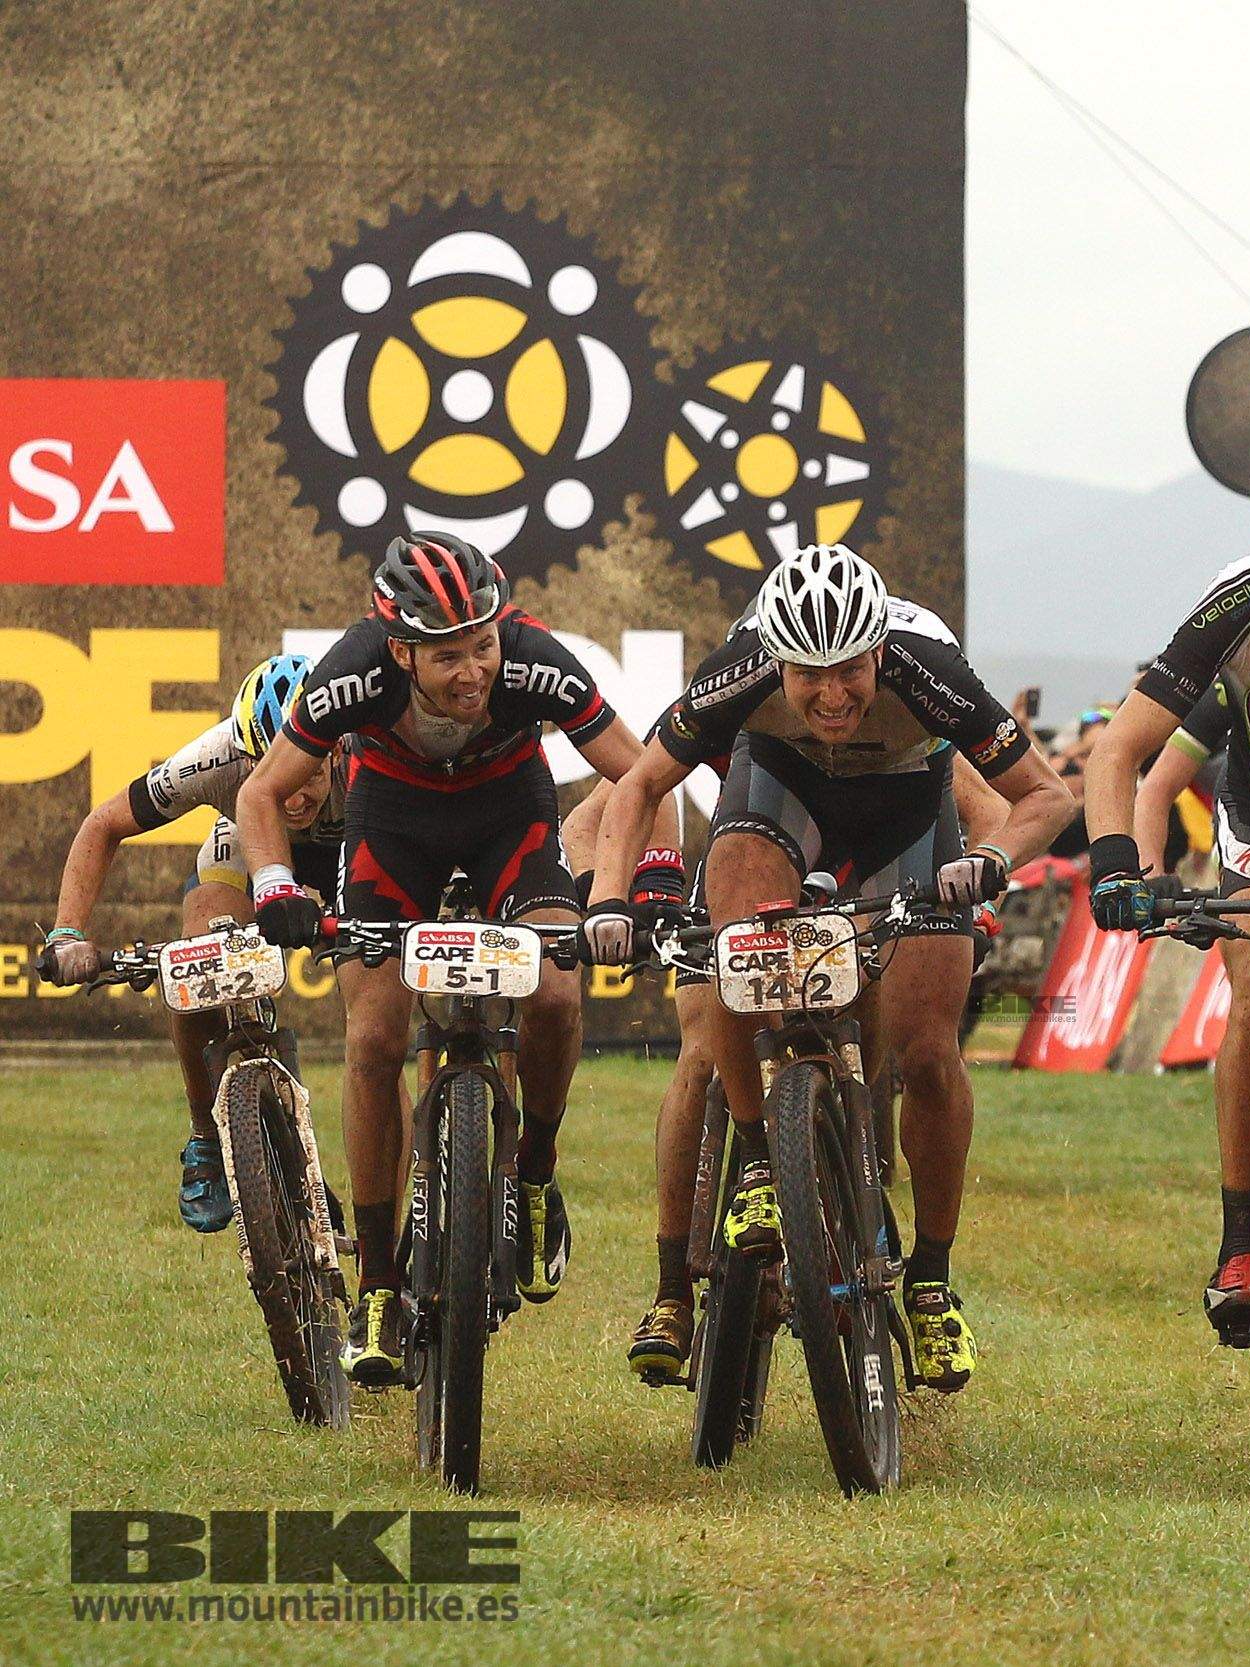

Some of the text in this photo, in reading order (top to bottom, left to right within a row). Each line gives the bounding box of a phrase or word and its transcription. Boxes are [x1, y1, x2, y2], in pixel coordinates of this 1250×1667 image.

[9, 438, 174, 533] SA
[868, 620, 883, 641] uvex
[503, 659, 588, 705] BMC
[890, 643, 976, 712] CENTURION
[306, 666, 383, 723] BMC
[910, 683, 961, 729] VAUDE
[415, 946, 475, 962] CAPE
[440, 933, 472, 943] ABSA
[750, 936, 784, 948] ABSA
[170, 957, 225, 981] CAPE
[444, 966, 500, 991] 5-1
[198, 971, 256, 1001] 4-2
[747, 972, 834, 1007] 14-2
[744, 1169, 771, 1184] SIDI
[411, 1177, 429, 1241] FOX
[503, 1176, 519, 1246] FOX
